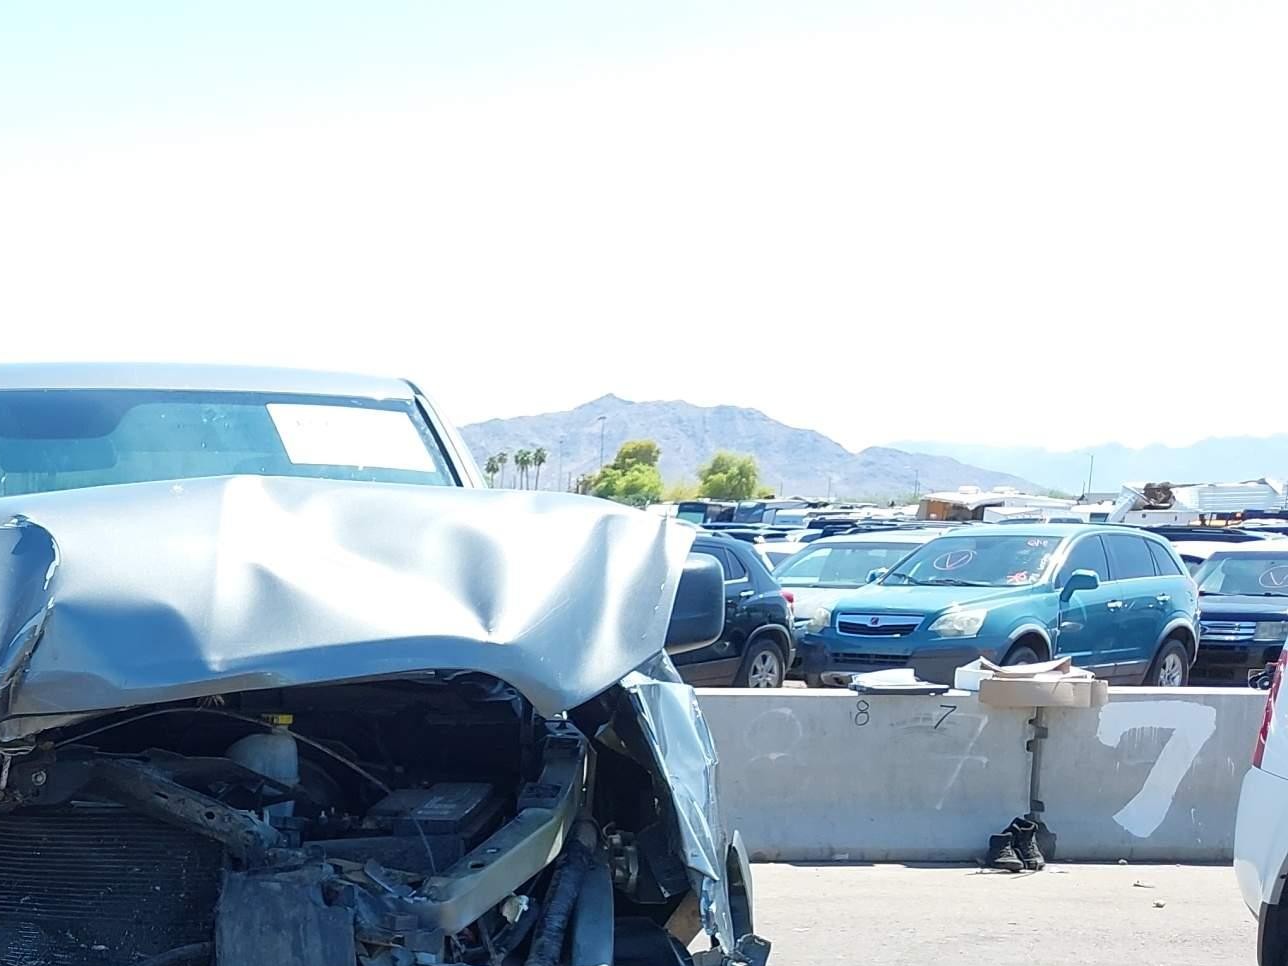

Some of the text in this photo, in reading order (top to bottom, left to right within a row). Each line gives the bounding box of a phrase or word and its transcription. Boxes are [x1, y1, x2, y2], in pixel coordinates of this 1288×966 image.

[855, 700, 870, 726] 8
[934, 704, 958, 730] 7
[1096, 700, 1217, 838] 7
